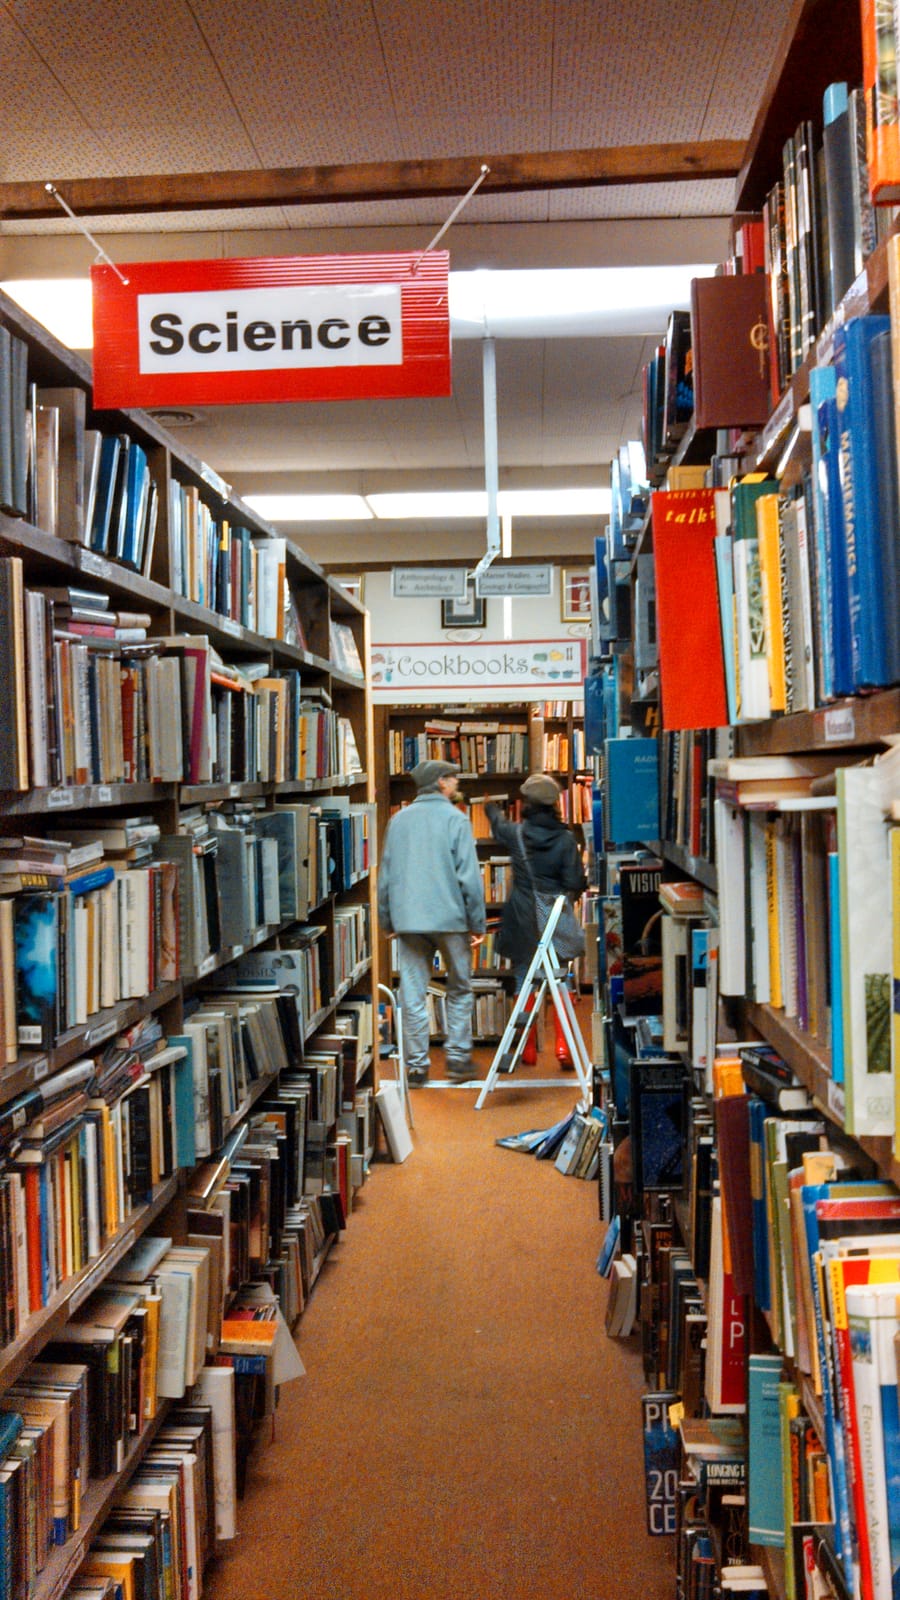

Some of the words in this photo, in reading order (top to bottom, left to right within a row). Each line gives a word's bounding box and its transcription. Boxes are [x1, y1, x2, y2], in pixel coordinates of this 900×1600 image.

[148, 310, 392, 356] Science
[841, 430, 857, 577] MATHEMATICS
[400, 573, 447, 583] Anthropology
[397, 654, 529, 676] Cookbooks
[22, 874, 49, 886] HUMAN
[842, 1387, 852, 1429] LINEAR
[706, 1463, 740, 1478] LONGING
[861, 1404, 875, 1507] Elementary
[868, 1514, 882, 1588] Algebra
